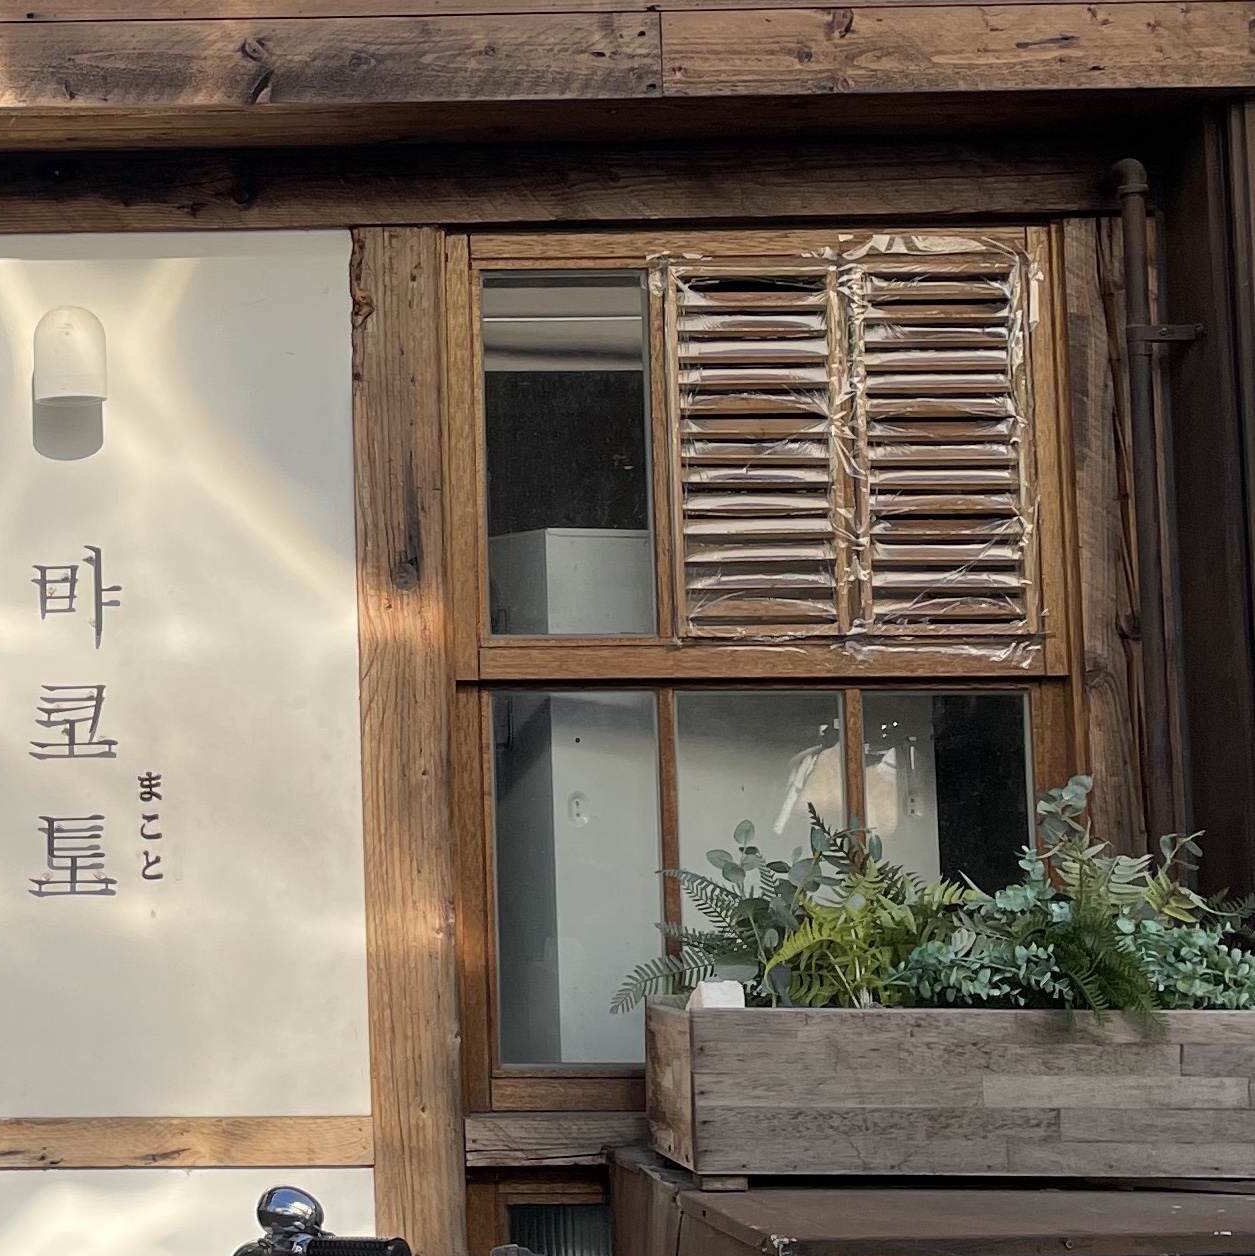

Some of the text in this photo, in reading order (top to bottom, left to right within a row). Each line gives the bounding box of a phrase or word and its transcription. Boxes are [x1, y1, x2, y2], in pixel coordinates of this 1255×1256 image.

[28, 545, 122, 898] 마코토
[137, 772, 164, 880] まこと
